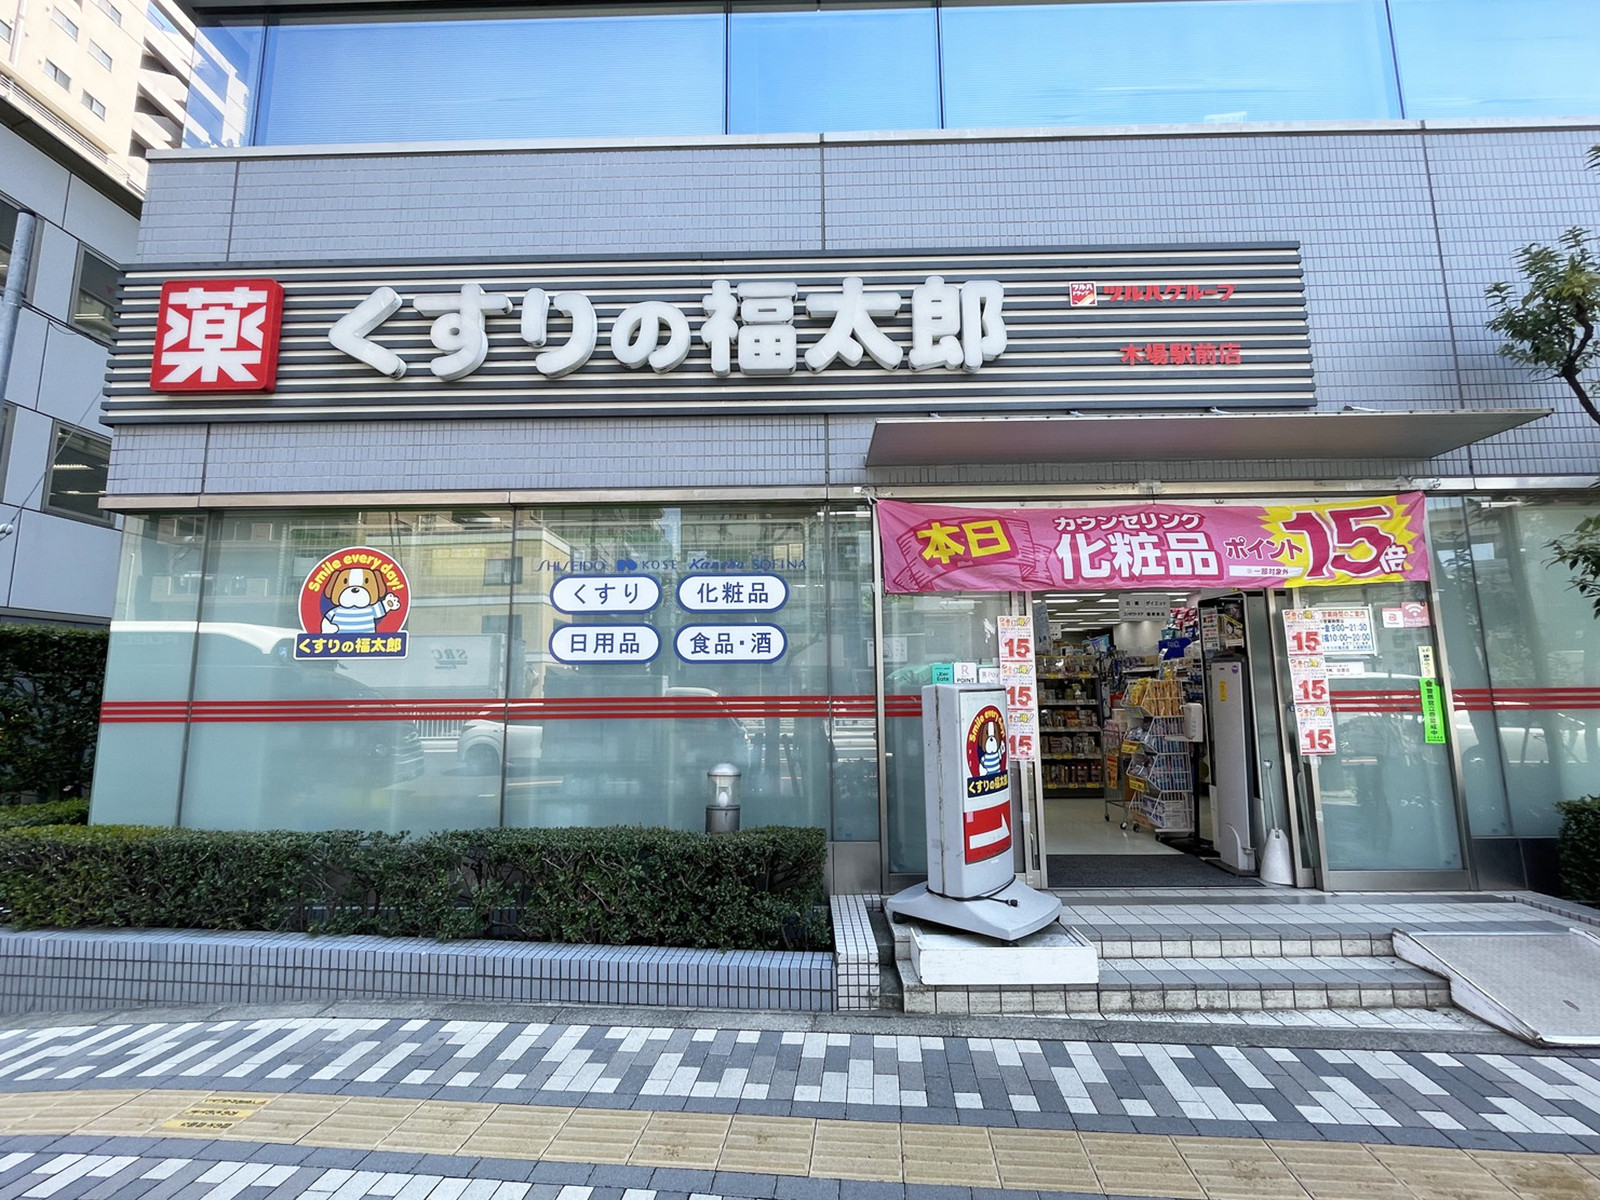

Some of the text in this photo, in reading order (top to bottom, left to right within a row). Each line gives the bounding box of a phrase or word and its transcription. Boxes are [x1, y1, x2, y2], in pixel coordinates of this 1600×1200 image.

[160, 286, 268, 384] 薬
[327, 276, 1008, 381] くすりの福太郎
[1120, 343, 1241, 366] 木場駅前店
[1054, 513, 1202, 531] カウンセリング
[917, 519, 1011, 563] 本日
[1225, 537, 1303, 560] ポイント
[532, 559, 606, 572] SHISEIDO
[751, 559, 807, 571] SOFINA
[1055, 532, 1219, 580] 化粧品
[309, 554, 405, 592] Smile every day!
[574, 584, 639, 604] くすり
[697, 582, 769, 604] 化粧品
[298, 637, 402, 654] くすりの福太郎
[570, 632, 640, 654] 日用品
[690, 632, 772, 655] 食品・酒
[1004, 638, 1031, 658] 15
[1291, 631, 1321, 651] 15
[1007, 686, 1033, 706] 15
[1298, 679, 1327, 700] 15
[969, 715, 984, 742] Smile
[1305, 728, 1334, 749] 15
